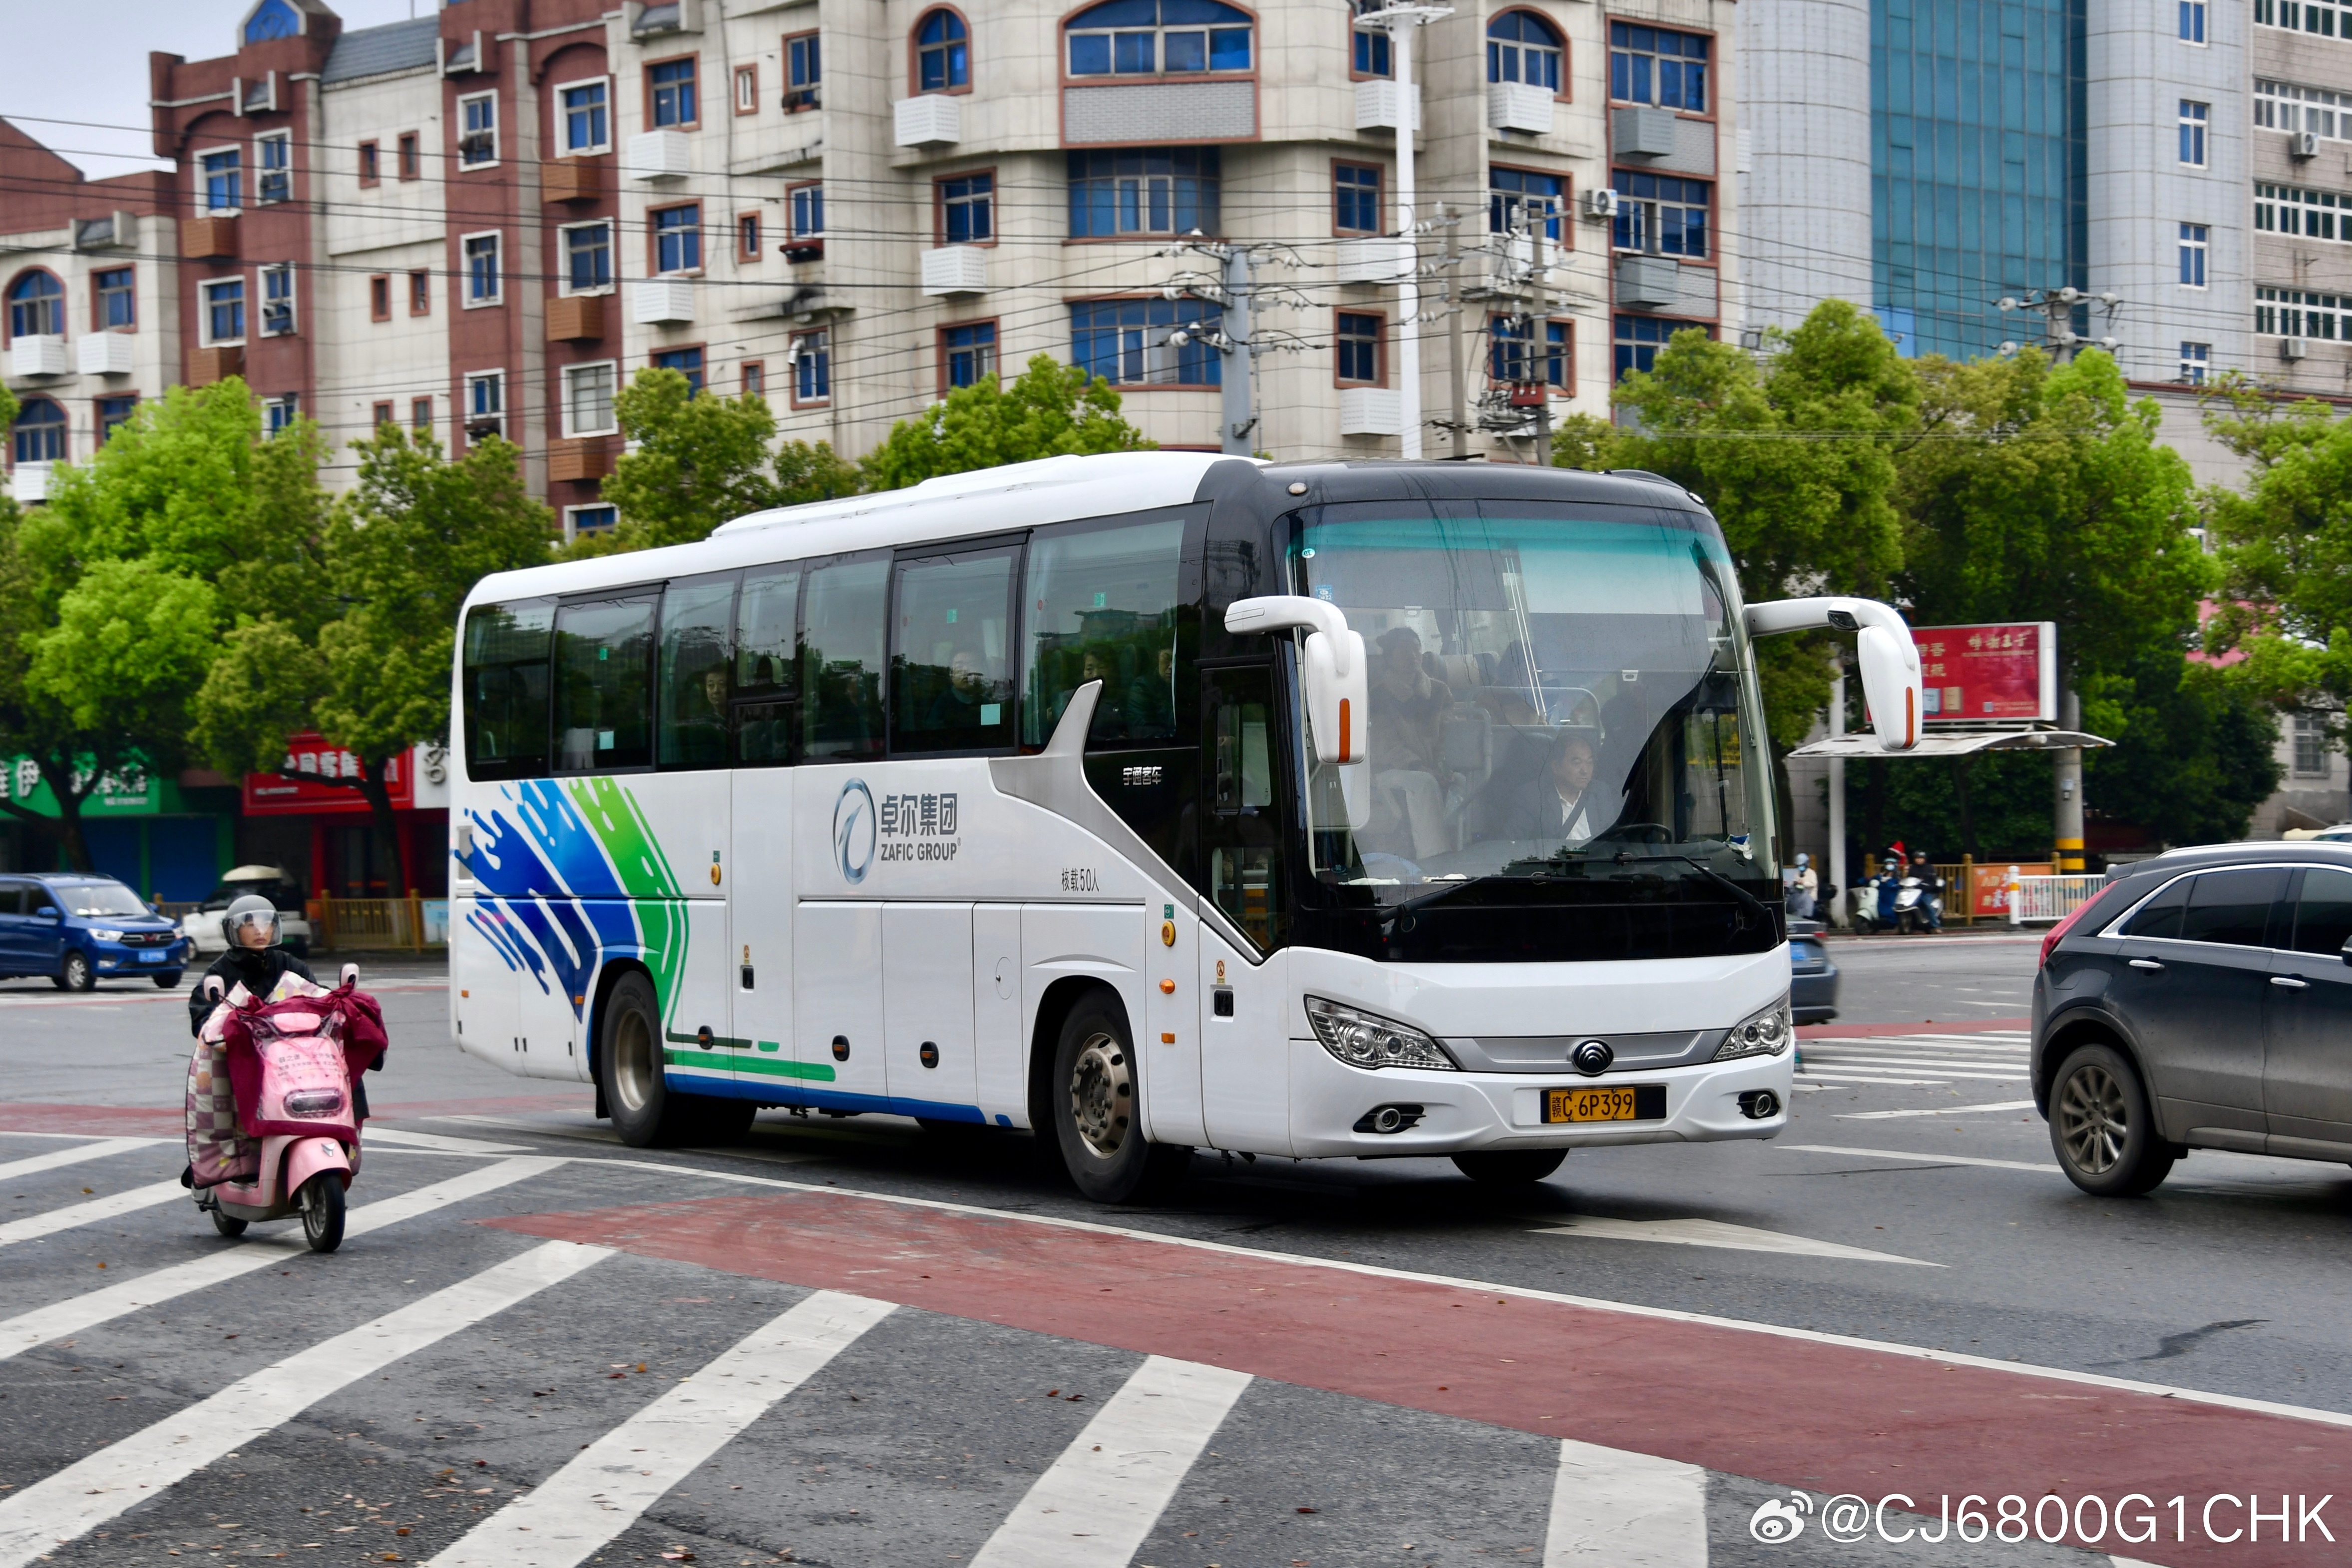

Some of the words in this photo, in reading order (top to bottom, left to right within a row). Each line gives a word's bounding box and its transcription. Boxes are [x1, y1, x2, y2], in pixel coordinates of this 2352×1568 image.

[1123, 766, 1163, 785] 宇通客车
[881, 792, 958, 838] 卓尔集团
[880, 843, 914, 861] ZAFIC
[917, 842, 957, 861] GROUP
[1061, 867, 1100, 892] 核载50人
